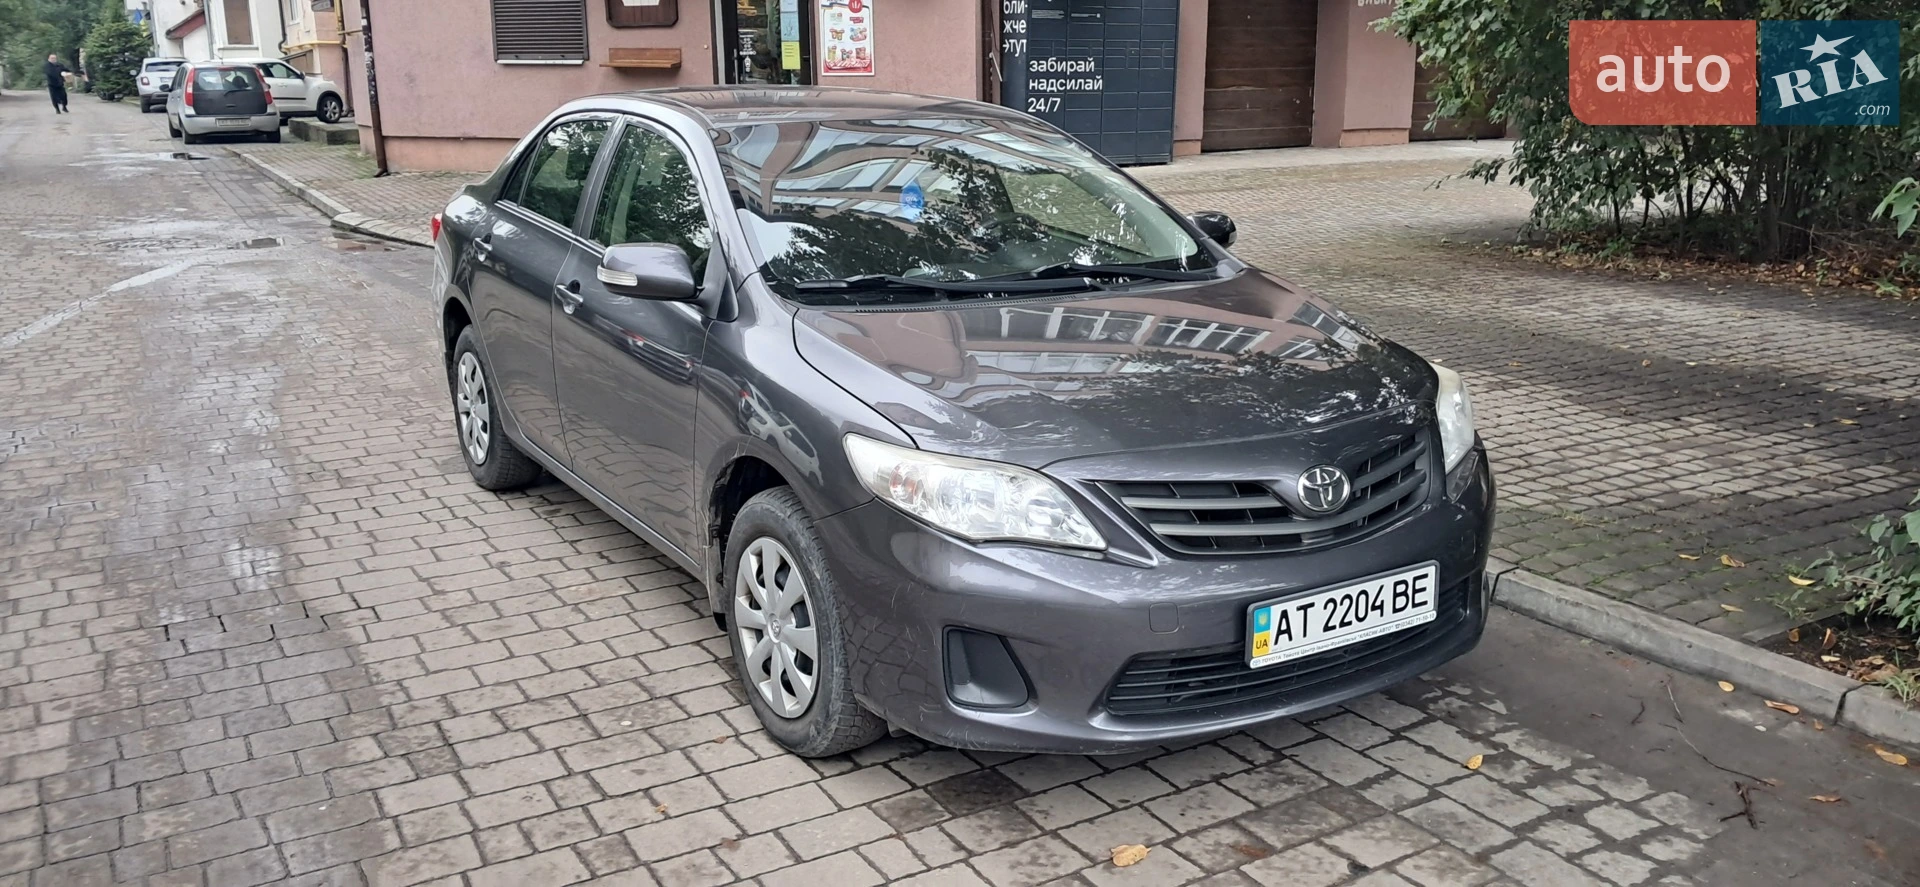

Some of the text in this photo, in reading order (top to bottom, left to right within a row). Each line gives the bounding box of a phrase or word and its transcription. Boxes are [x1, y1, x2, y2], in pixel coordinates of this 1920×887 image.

[1003, 19, 1027, 34] жче
[1029, 57, 1095, 75] забирай
[1029, 76, 1103, 93] надсилай
[1027, 97, 1061, 113] 24/7
[1273, 573, 1429, 646] AT 2204 BE
[1255, 638, 1269, 650] UA
